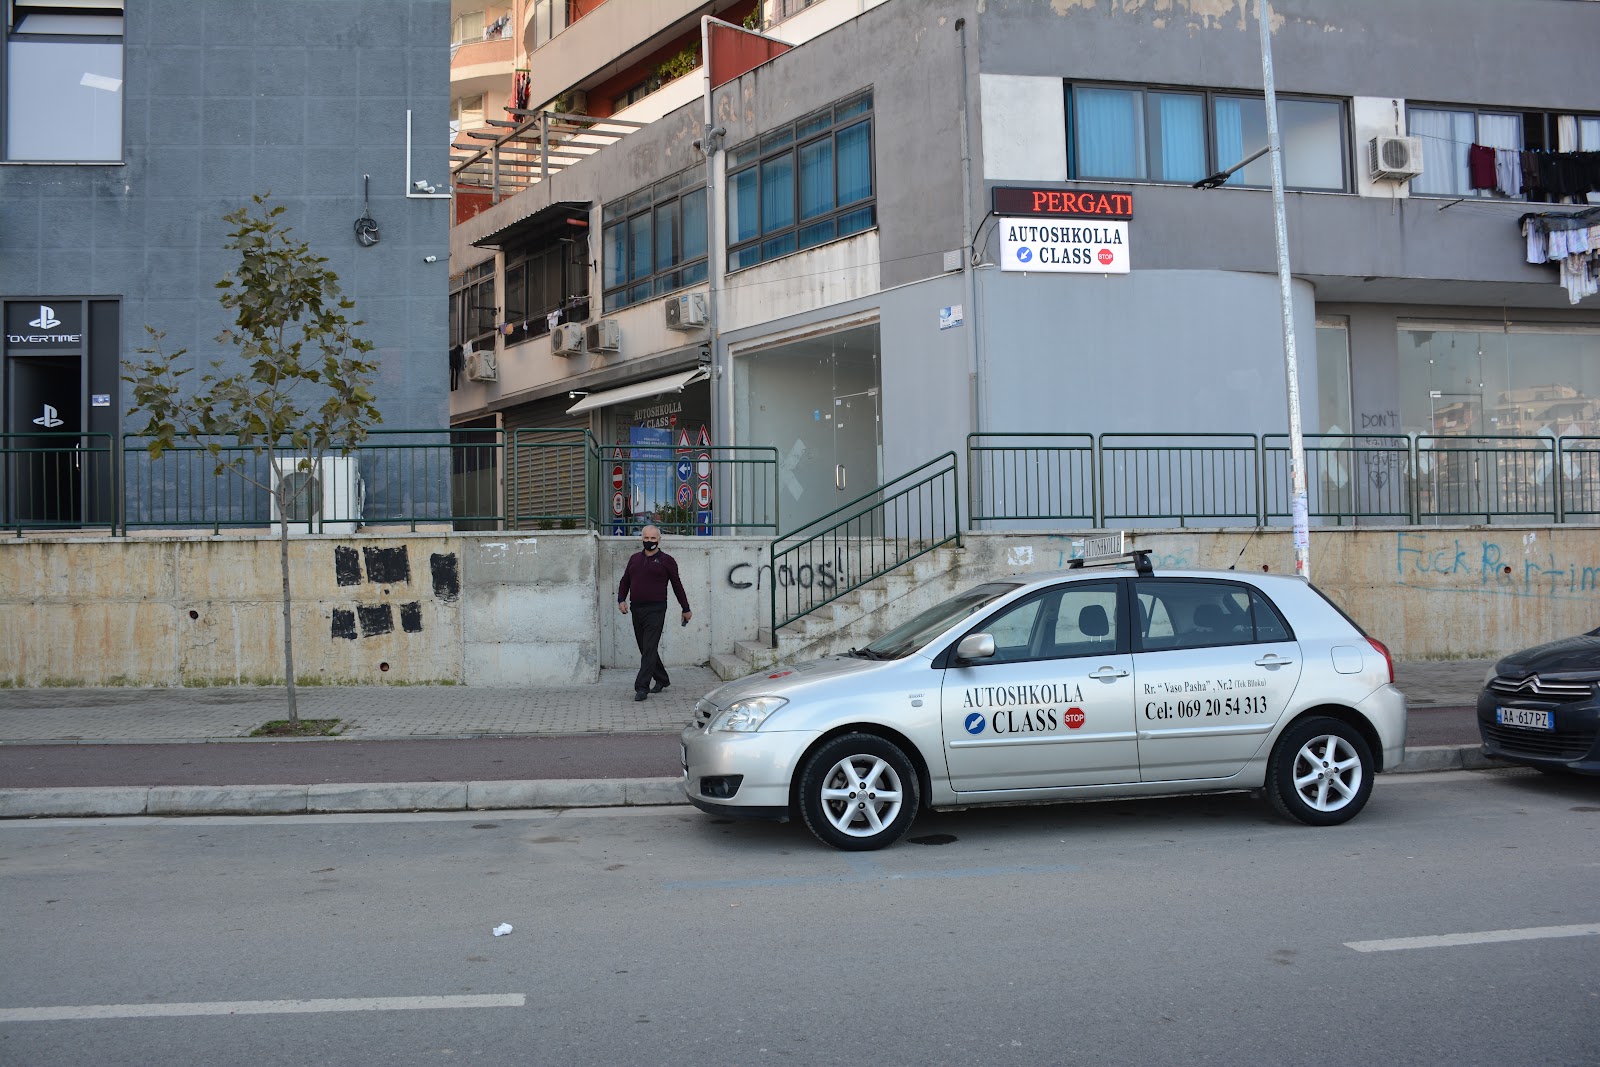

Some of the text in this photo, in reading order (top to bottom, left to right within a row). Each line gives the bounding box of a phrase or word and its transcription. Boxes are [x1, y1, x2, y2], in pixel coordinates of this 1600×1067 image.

[1008, 225, 1123, 245] AUTOSHKOLLA
[1039, 246, 1092, 264] CLASS
[634, 401, 682, 420] AUTOSHKOLLA
[646, 416, 669, 428] CLASS
[963, 683, 1084, 708] AUTOSHKOLLA
[1143, 683, 1156, 695] Rr.
[1217, 679, 1233, 691] Nr.2
[1145, 695, 1267, 720] Cel: 069 20 54 313
[992, 708, 1057, 734] CLASS
[1064, 714, 1084, 722] STOP
